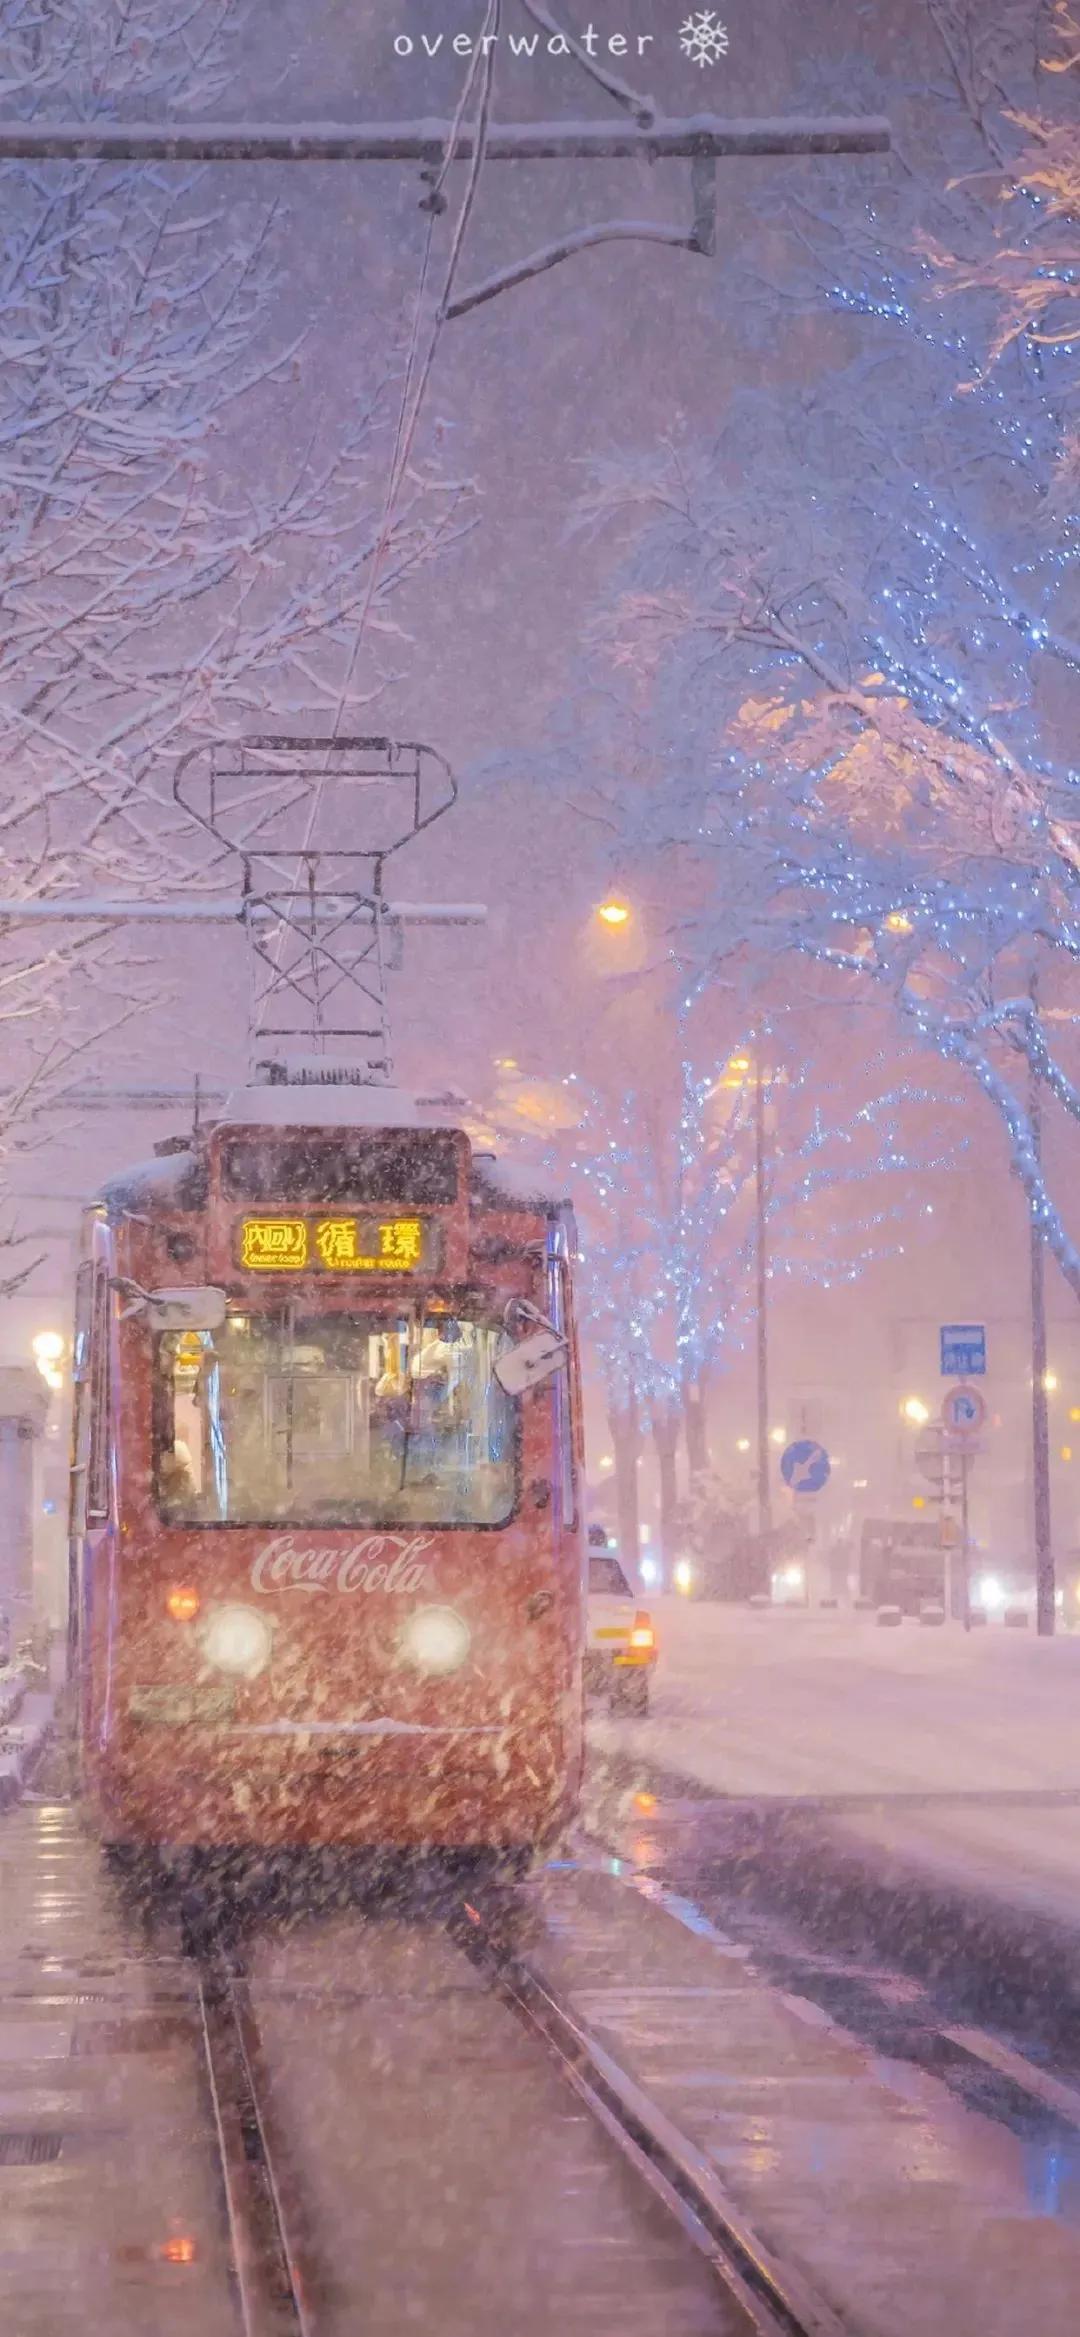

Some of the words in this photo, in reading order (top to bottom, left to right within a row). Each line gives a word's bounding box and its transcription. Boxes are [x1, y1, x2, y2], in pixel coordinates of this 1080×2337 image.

[247, 1225, 303, 1253] 内回り
[251, 1535, 436, 1594] Coca-Cola
